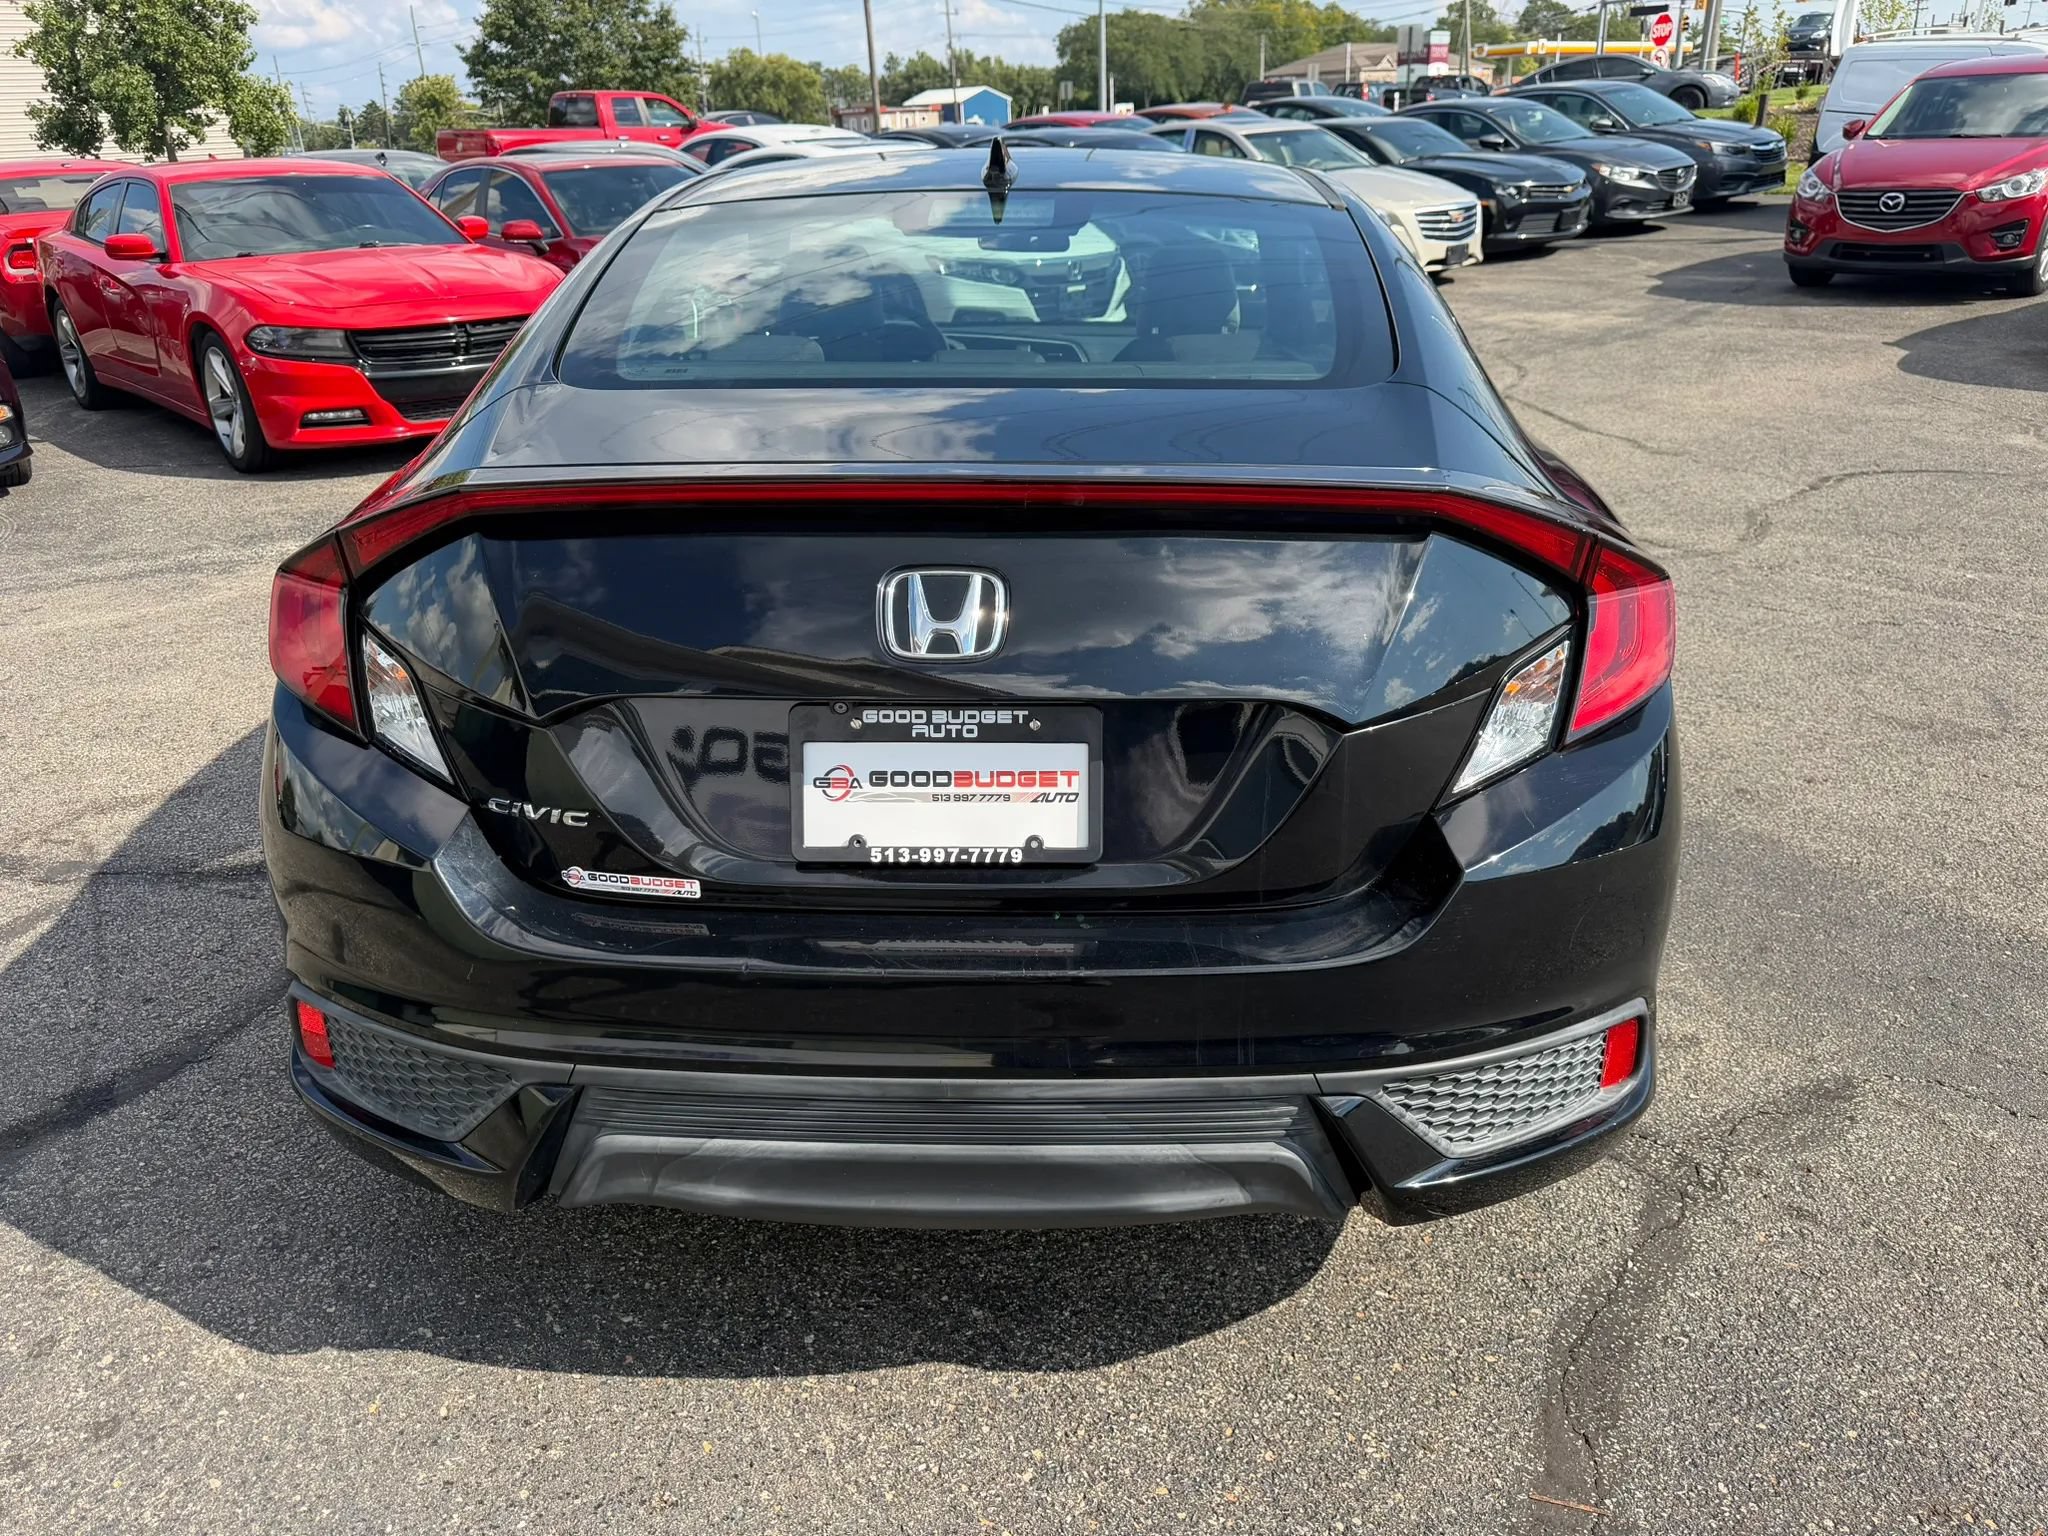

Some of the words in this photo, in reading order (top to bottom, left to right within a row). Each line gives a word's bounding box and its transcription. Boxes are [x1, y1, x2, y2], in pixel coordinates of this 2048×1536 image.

[1652, 22, 1673, 39] STOP
[862, 709, 927, 724] GOOD
[931, 709, 1029, 724] BUDGET
[911, 724, 979, 738] AUTO
[812, 777, 863, 790] GBA
[868, 770, 1080, 788] GOODBUDGET
[931, 793, 951, 802] 513
[953, 793, 977, 802] 997
[979, 793, 1011, 802] 7779
[1030, 792, 1080, 803] AUTO
[487, 797, 590, 828] CIVIC
[869, 847, 1024, 864] 513-997-7779
[587, 872, 697, 889] GOODBUDGET
[672, 889, 698, 897] AUTO
